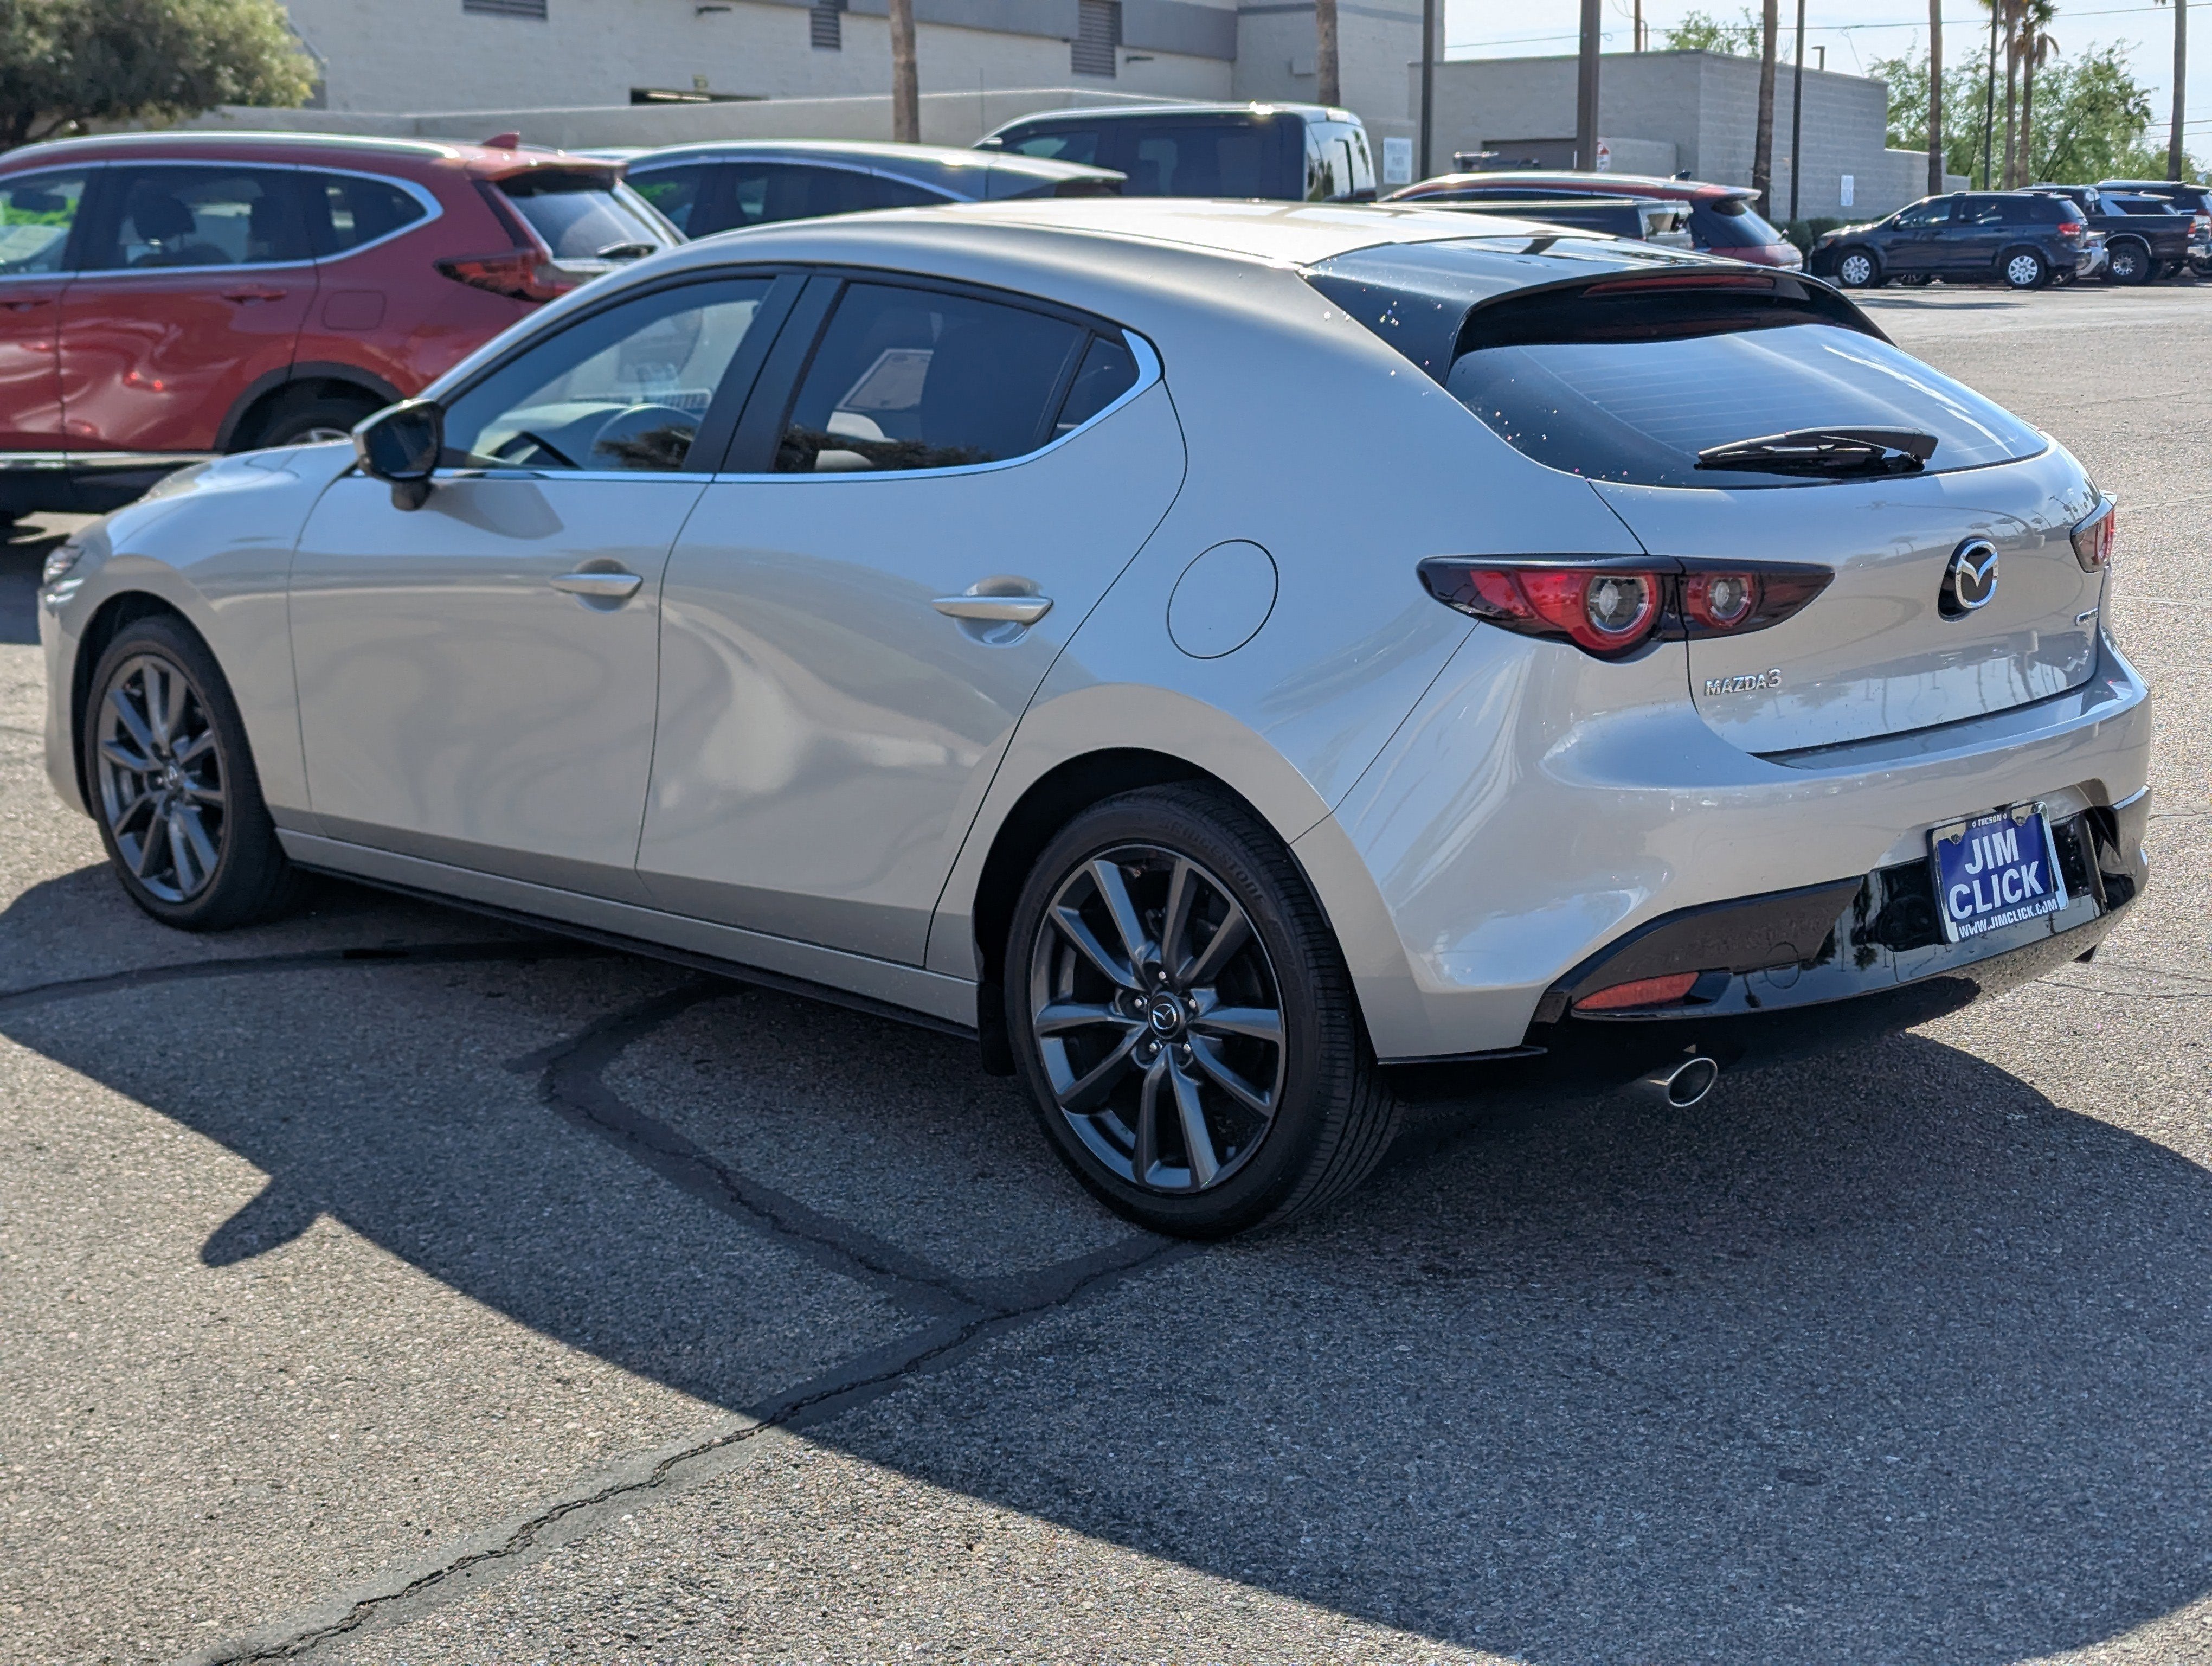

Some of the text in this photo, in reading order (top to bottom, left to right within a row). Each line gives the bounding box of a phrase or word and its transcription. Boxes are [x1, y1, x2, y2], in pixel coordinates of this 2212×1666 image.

[1977, 813, 2002, 827] TUCSON
[1964, 828, 2020, 874] JIM
[1949, 861, 2044, 920] CLICK
[1958, 898, 2058, 938] WWW.JIMCLICK.COM
